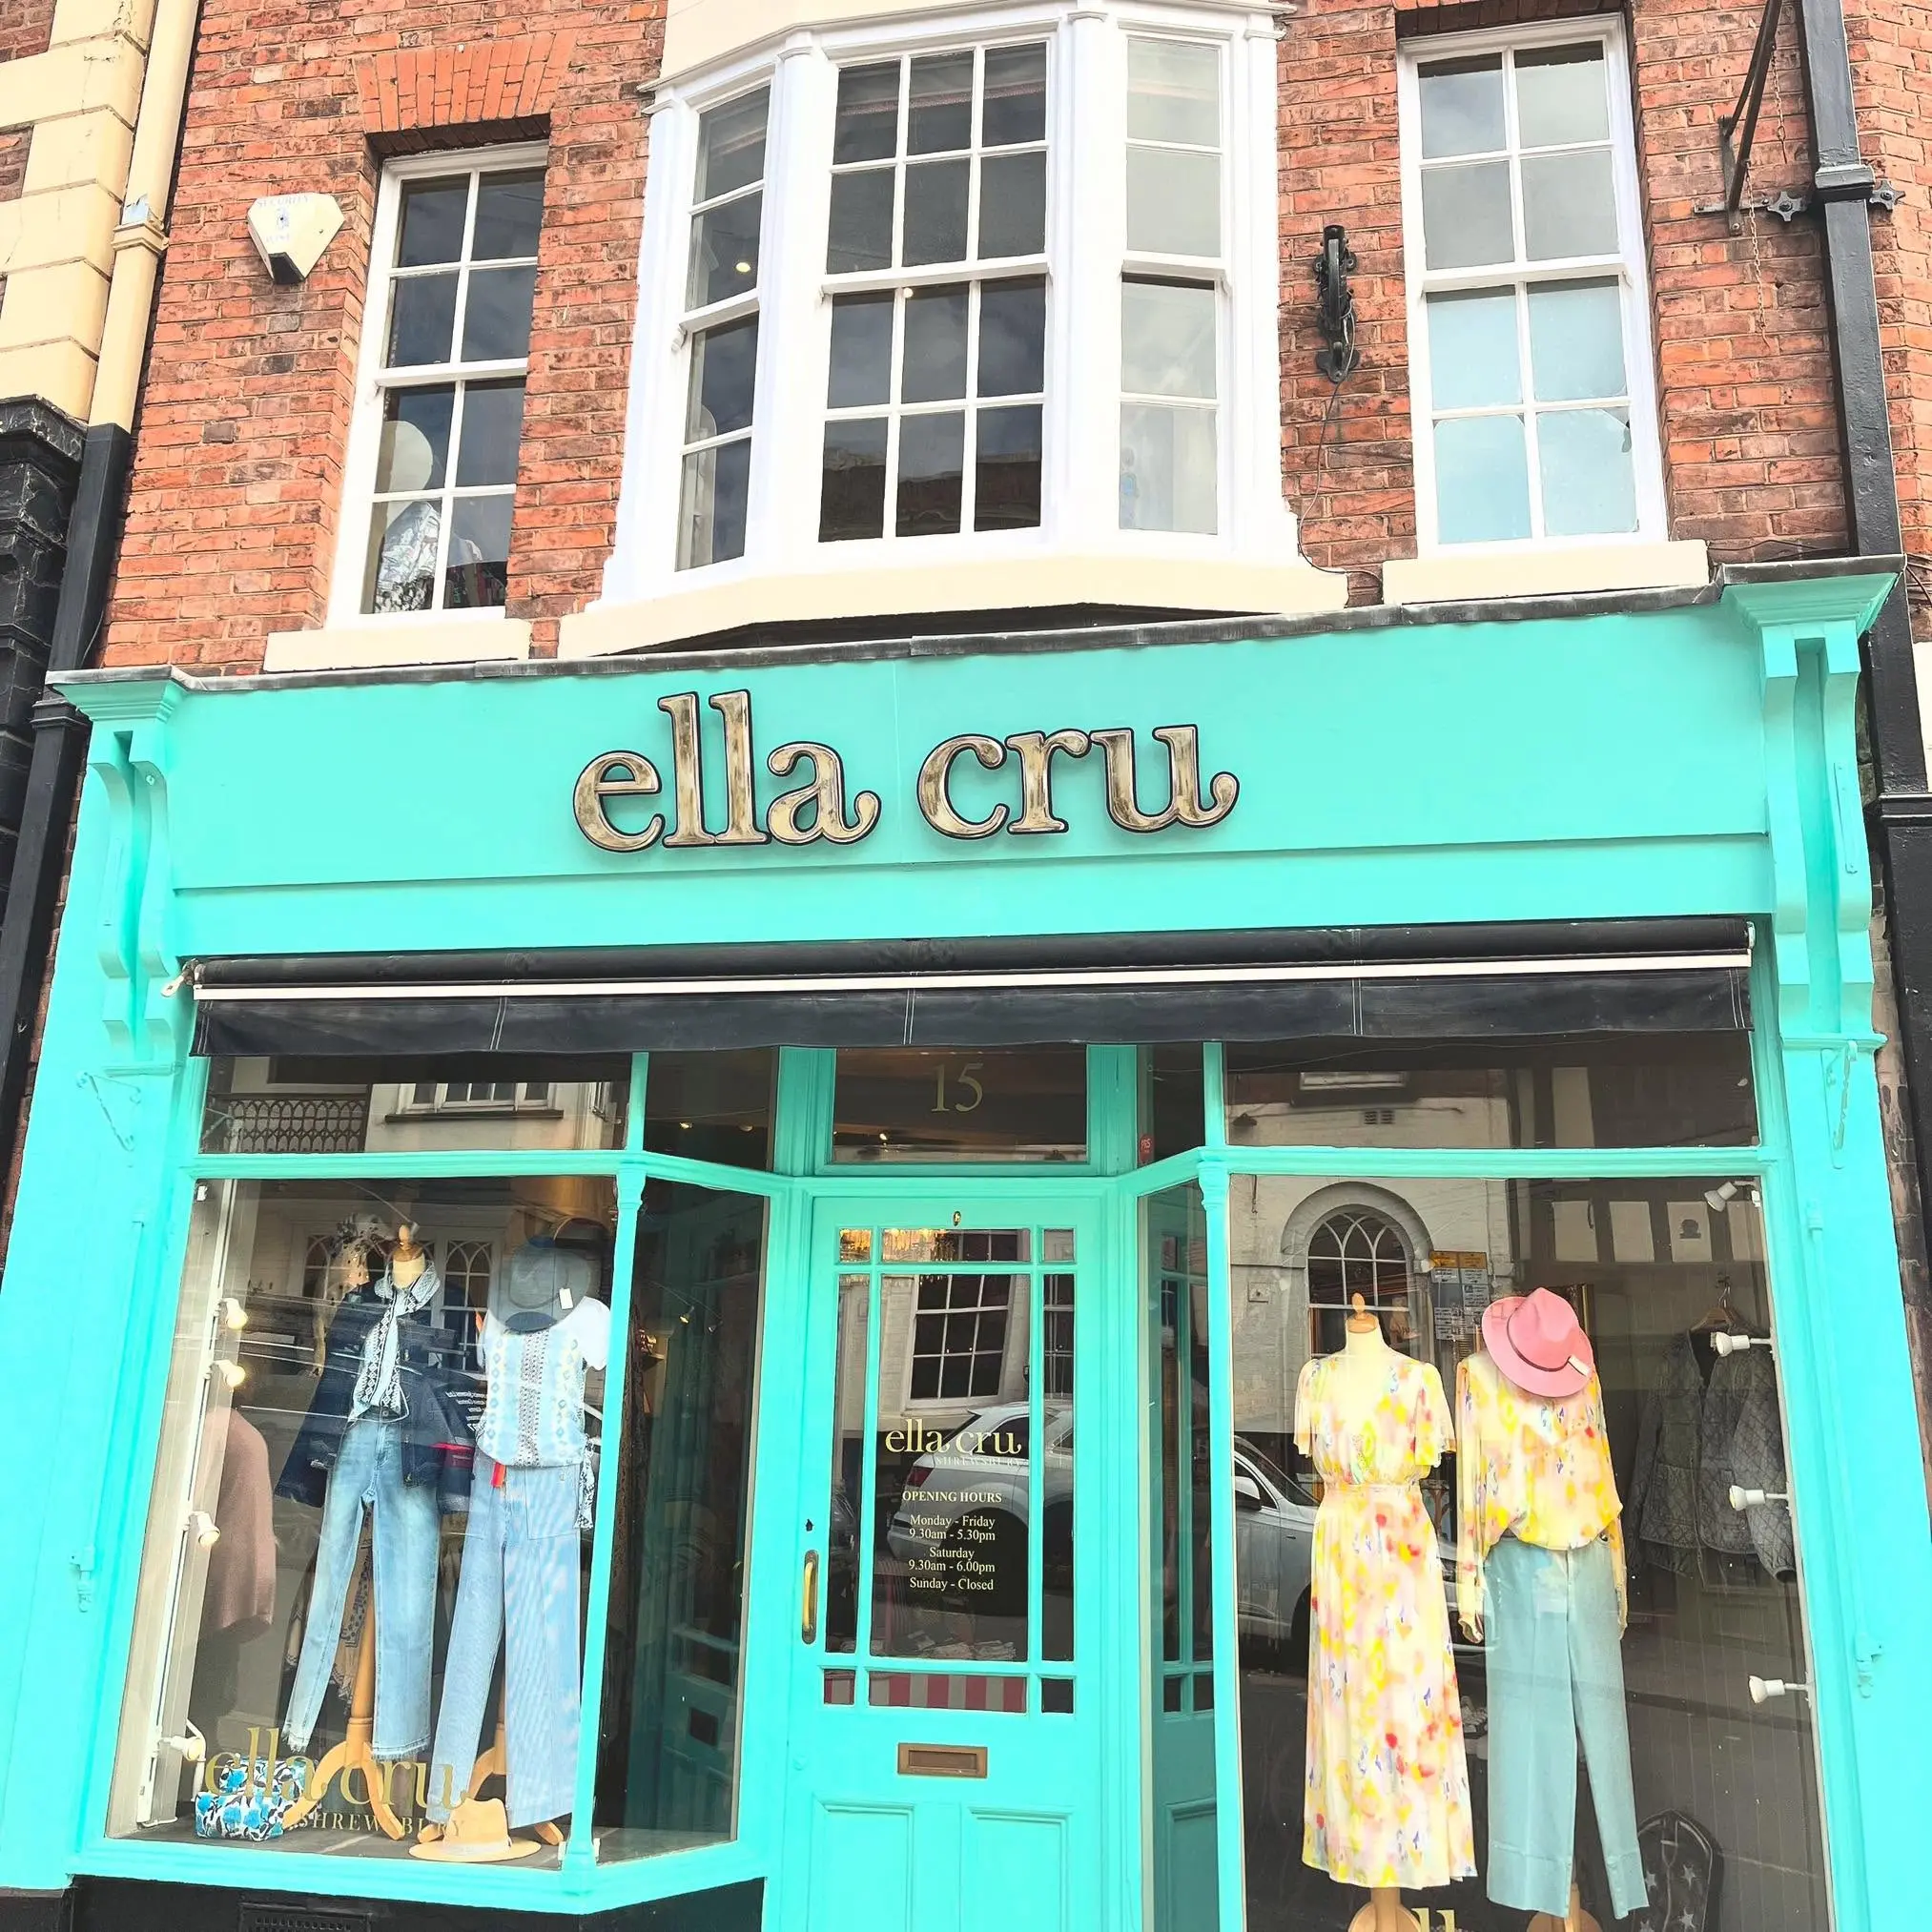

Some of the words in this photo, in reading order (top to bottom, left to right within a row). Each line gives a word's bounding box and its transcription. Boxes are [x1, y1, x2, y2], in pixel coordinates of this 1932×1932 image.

[573, 689, 882, 853] ella
[916, 724, 1240, 840] cru
[931, 1062, 984, 1112] 15
[885, 1418, 950, 1453] ella
[956, 1429, 1022, 1454] cru
[902, 1490, 957, 1502] OPENING
[959, 1490, 1002, 1503] HOURS
[910, 1514, 952, 1529] Monday
[962, 1515, 996, 1530] Friday
[909, 1529, 947, 1539] 9.30am
[956, 1529, 996, 1543] 5.30pm
[929, 1547, 975, 1560] Saturday
[908, 1560, 946, 1572] 9.30am
[956, 1561, 996, 1574] 6.00pm
[910, 1577, 948, 1591] Sunday
[957, 1578, 994, 1591] Closed
[204, 1727, 327, 1803] ella
[339, 1760, 478, 1811] cru
[298, 1811, 465, 1838] SHREWBRY
